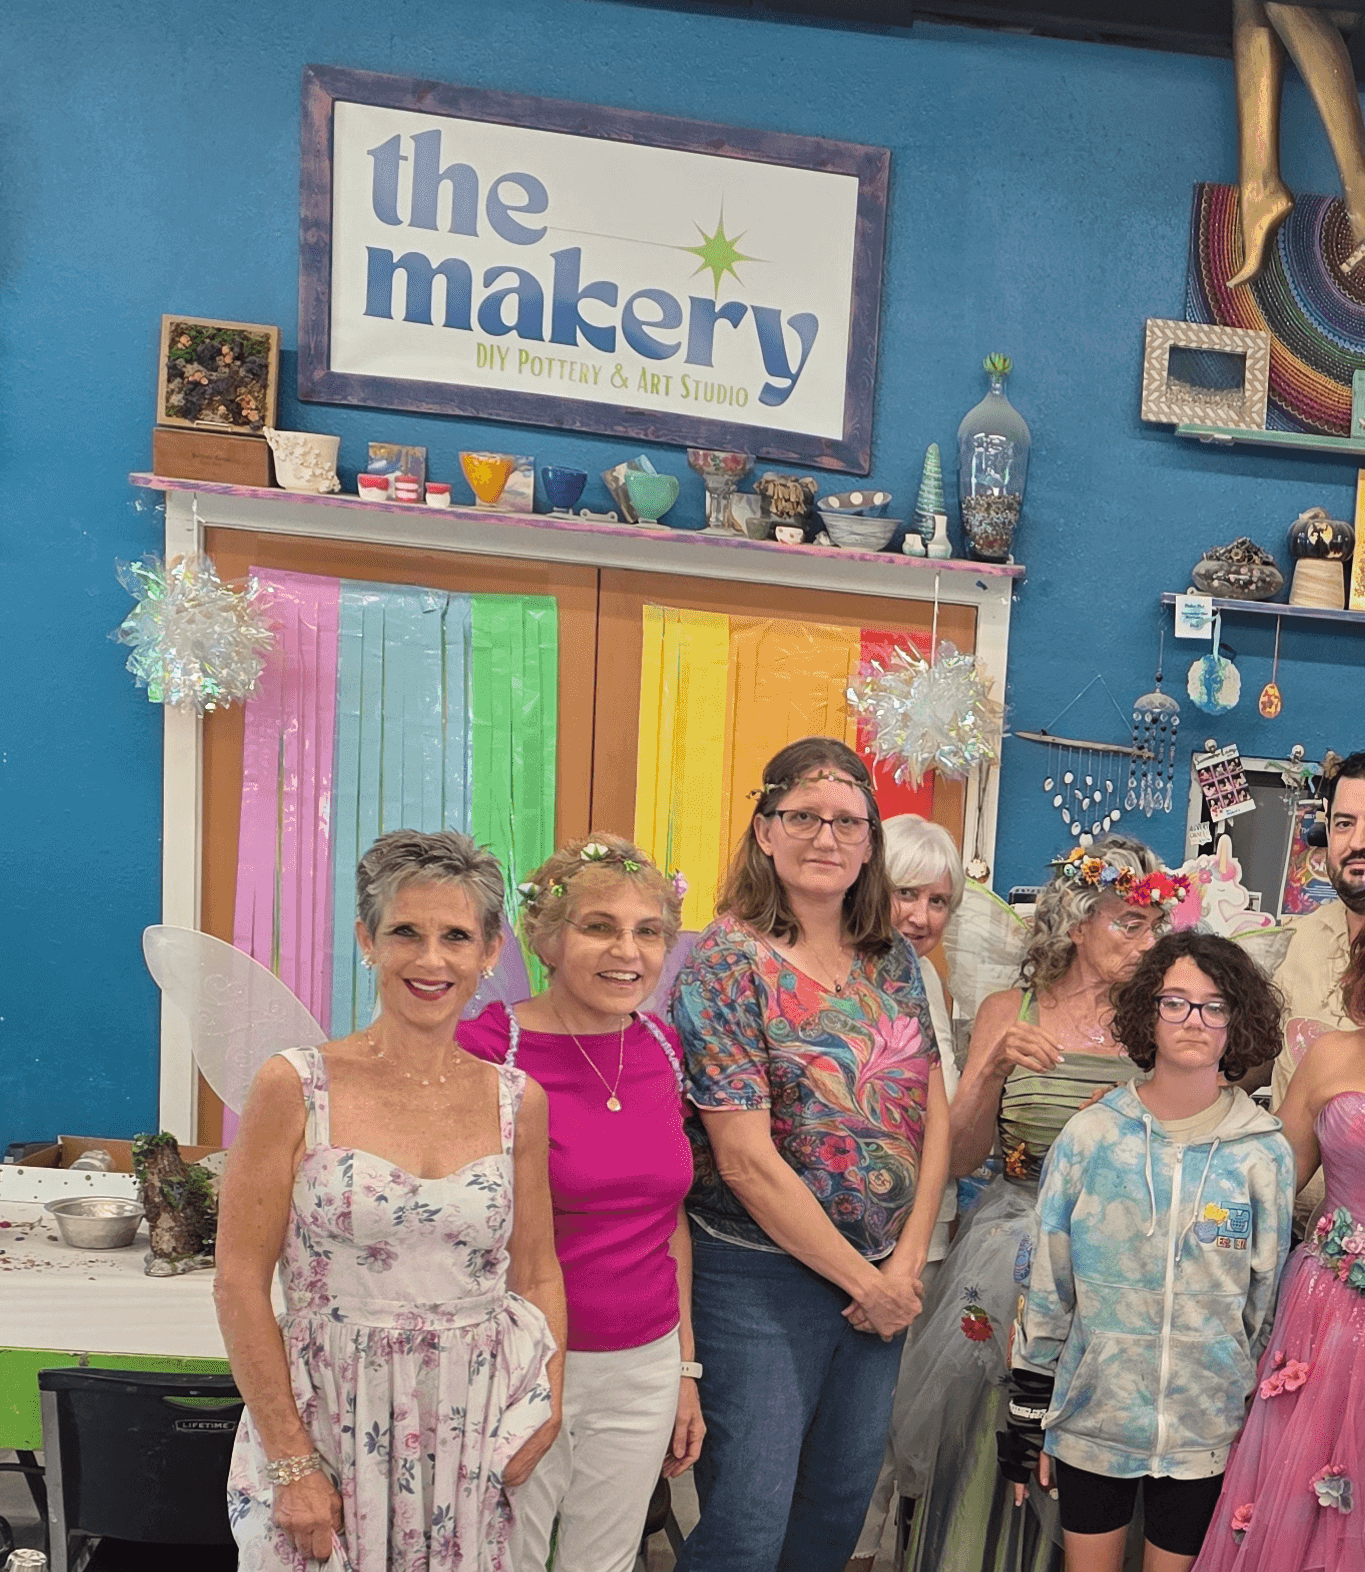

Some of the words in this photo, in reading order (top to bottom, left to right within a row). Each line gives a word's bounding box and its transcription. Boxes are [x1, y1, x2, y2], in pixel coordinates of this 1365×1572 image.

[366, 128, 549, 246] the
[363, 245, 819, 407] makery
[476, 341, 510, 371] DIY
[518, 348, 602, 386] POTTERY
[610, 363, 629, 388] &
[637, 366, 673, 396] ART
[681, 373, 749, 408] STUDIO
